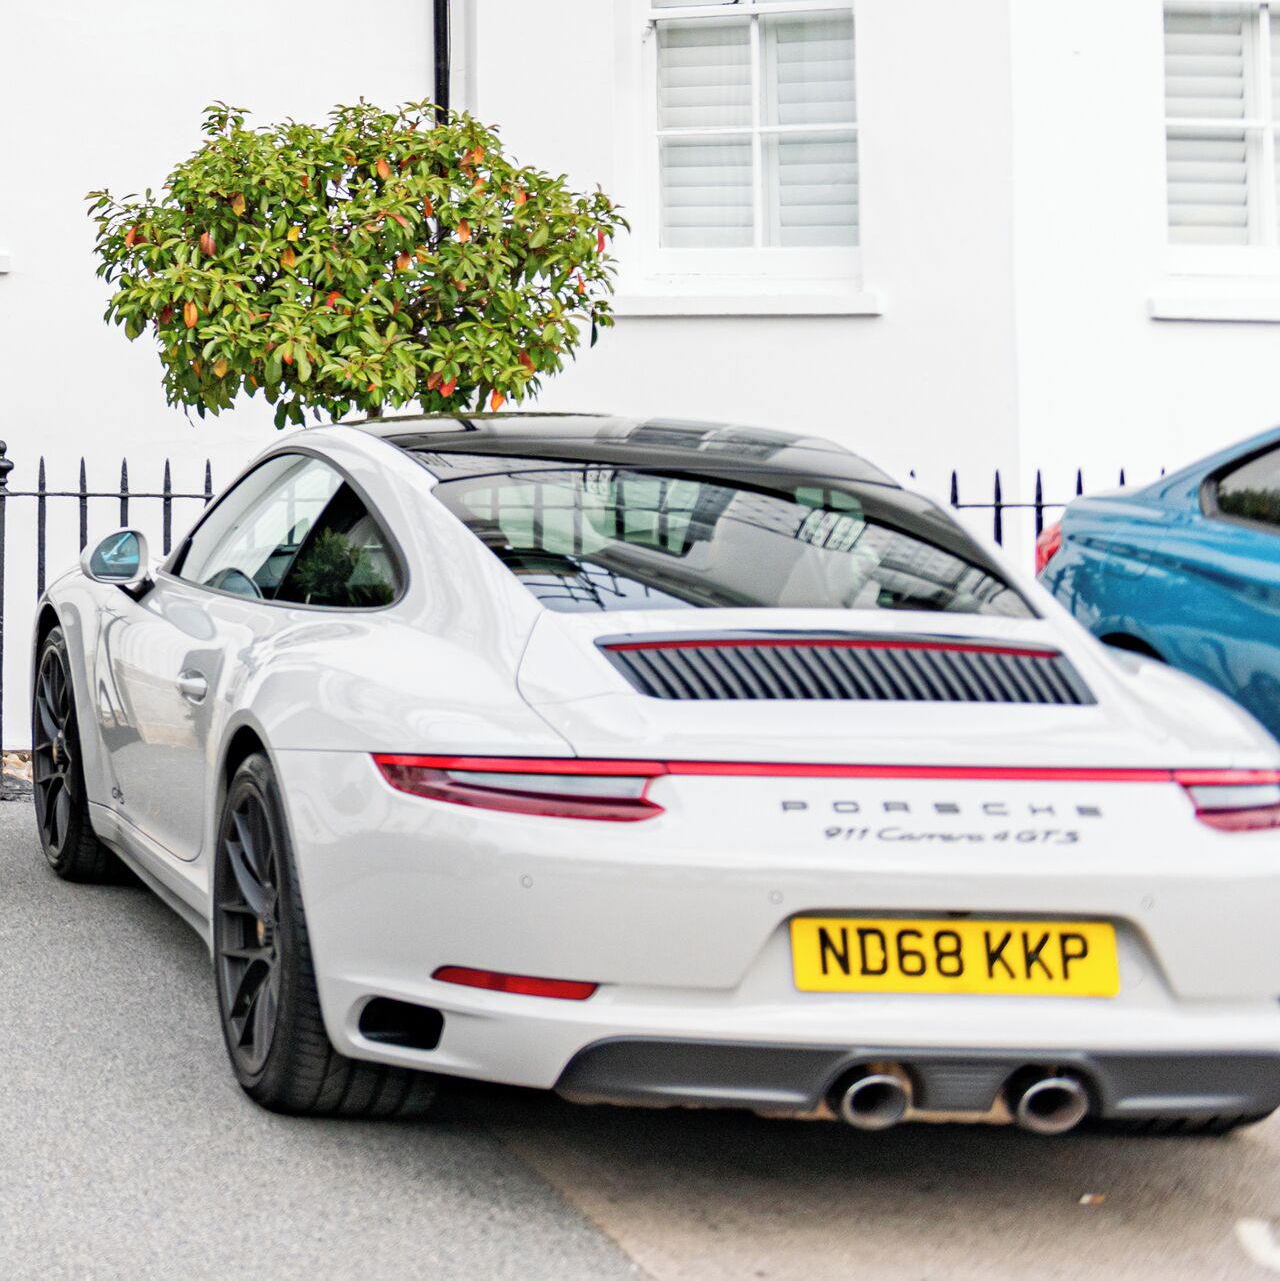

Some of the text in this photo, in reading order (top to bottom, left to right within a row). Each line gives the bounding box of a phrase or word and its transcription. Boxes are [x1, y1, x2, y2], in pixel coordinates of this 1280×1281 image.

[781, 800, 1103, 817] PORSCHE
[825, 827, 868, 840] 911
[877, 827, 985, 843] Carrera
[818, 927, 1090, 981] ND68 KKP
